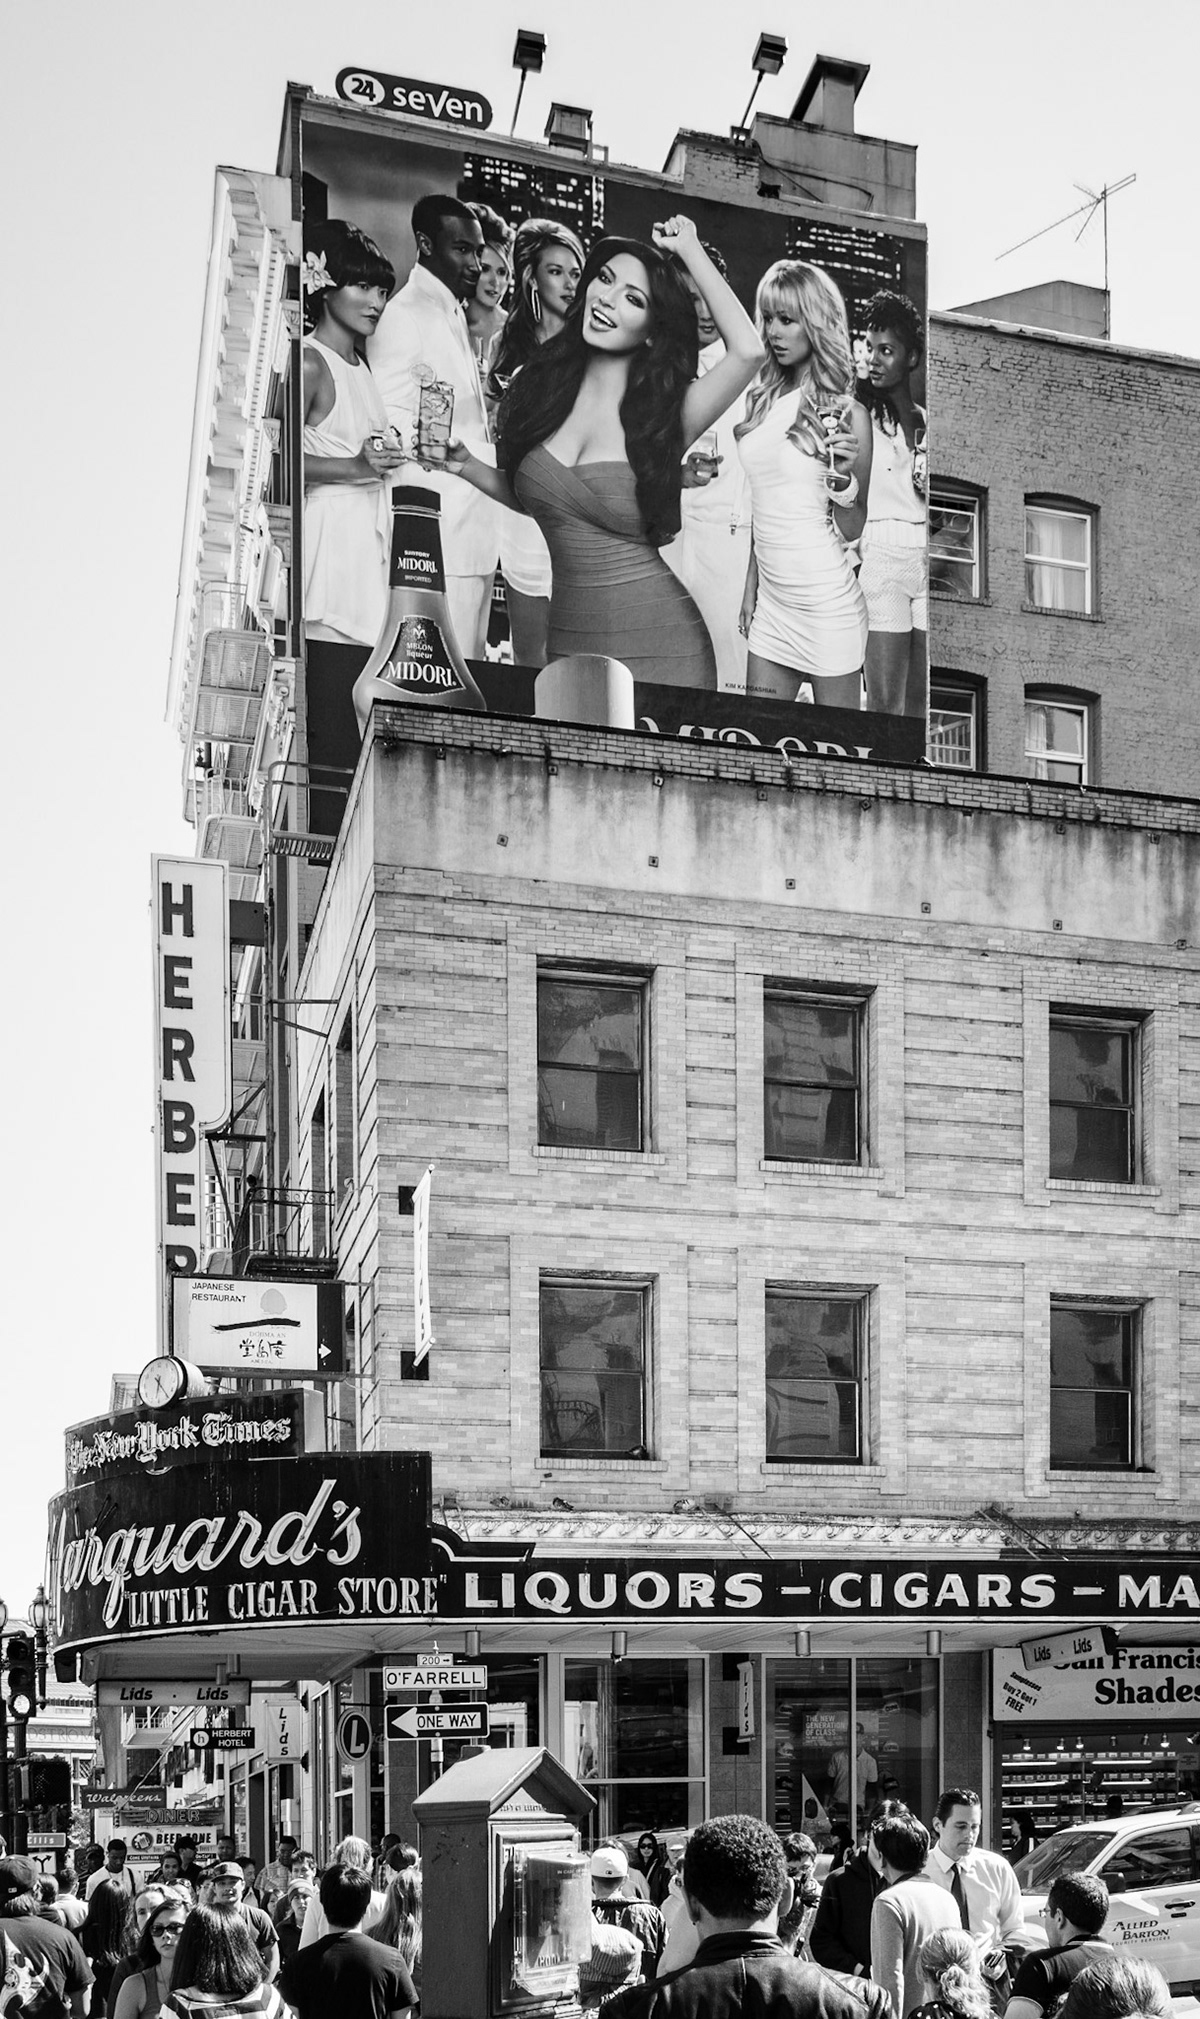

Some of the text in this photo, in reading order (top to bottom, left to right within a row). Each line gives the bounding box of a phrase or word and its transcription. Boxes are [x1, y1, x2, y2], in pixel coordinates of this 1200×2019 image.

[351, 77, 376, 102] 24
[406, 642, 433, 652] MELON
[406, 650, 433, 659] liqueur
[192, 1282, 235, 1291] JAPANESE
[191, 1293, 247, 1302] RESTAURANT
[91, 1431, 137, 1468] New
[134, 1416, 200, 1463] York
[202, 1411, 292, 1447] Times
[227, 1579, 319, 1620] CIGAR
[464, 1571, 764, 1614] LIQUORS
[828, 1571, 1057, 1609] CIGARS
[1073, 1637, 1093, 1655] Lids
[421, 1656, 441, 1665] 200
[1033, 1645, 1051, 1663] Lids
[386, 1671, 482, 1685] O'FARRELL
[119, 1687, 153, 1701] Lids
[196, 1687, 229, 1701] Lids
[1002, 1682, 1017, 1695] Buy
[1015, 1689, 1022, 1697] 2
[1020, 1692, 1033, 1704] Get
[1005, 1696, 1025, 1713] FREE
[417, 1714, 477, 1729] ONE WAY
[211, 1730, 252, 1738] HERBERT
[278, 1707, 289, 1756] Lids
[218, 1739, 247, 1747] HOTEL
[86, 1793, 162, 1804] Waleens
[145, 1808, 200, 1823] DINER
[1112, 1920, 1159, 1932] ALLIED
[1122, 1929, 1170, 1941] BARTON
